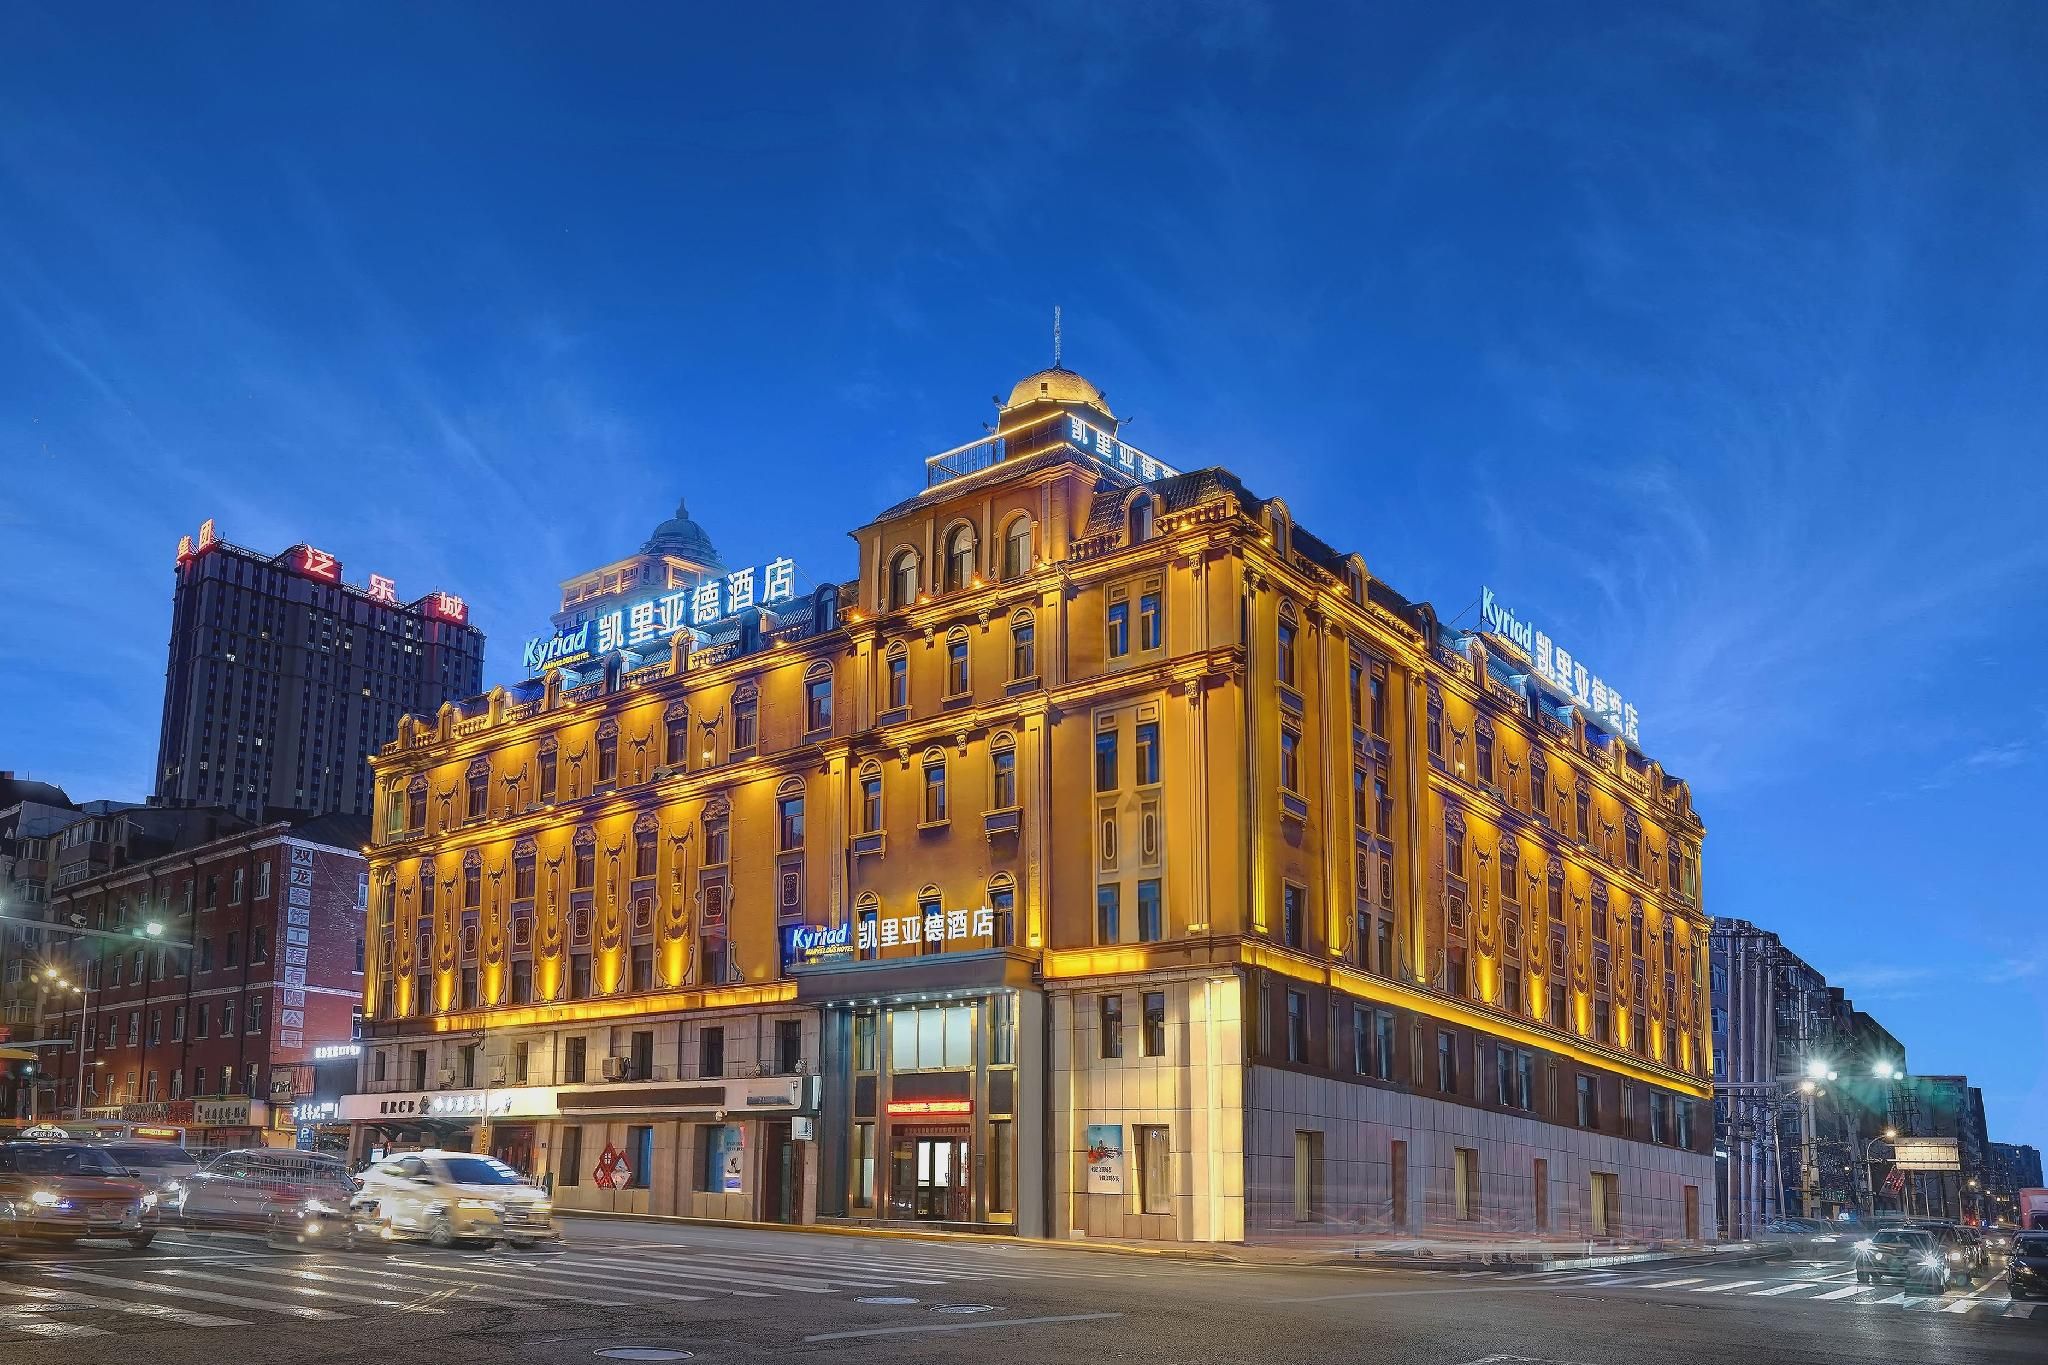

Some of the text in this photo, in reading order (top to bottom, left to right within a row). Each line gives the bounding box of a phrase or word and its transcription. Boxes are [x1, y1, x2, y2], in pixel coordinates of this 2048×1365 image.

[1071, 417, 1182, 481] 凯里亚德
[522, 556, 794, 672] Kyriad 凯里亚德酒店
[1481, 585, 1639, 747] Kyriad 凯里亚德酒店
[281, 847, 314, 1048] 双龙装饰工程有限公司
[792, 905, 995, 950] Kyriad 凯里亚德酒店
[300, 1127, 310, 1139] P
